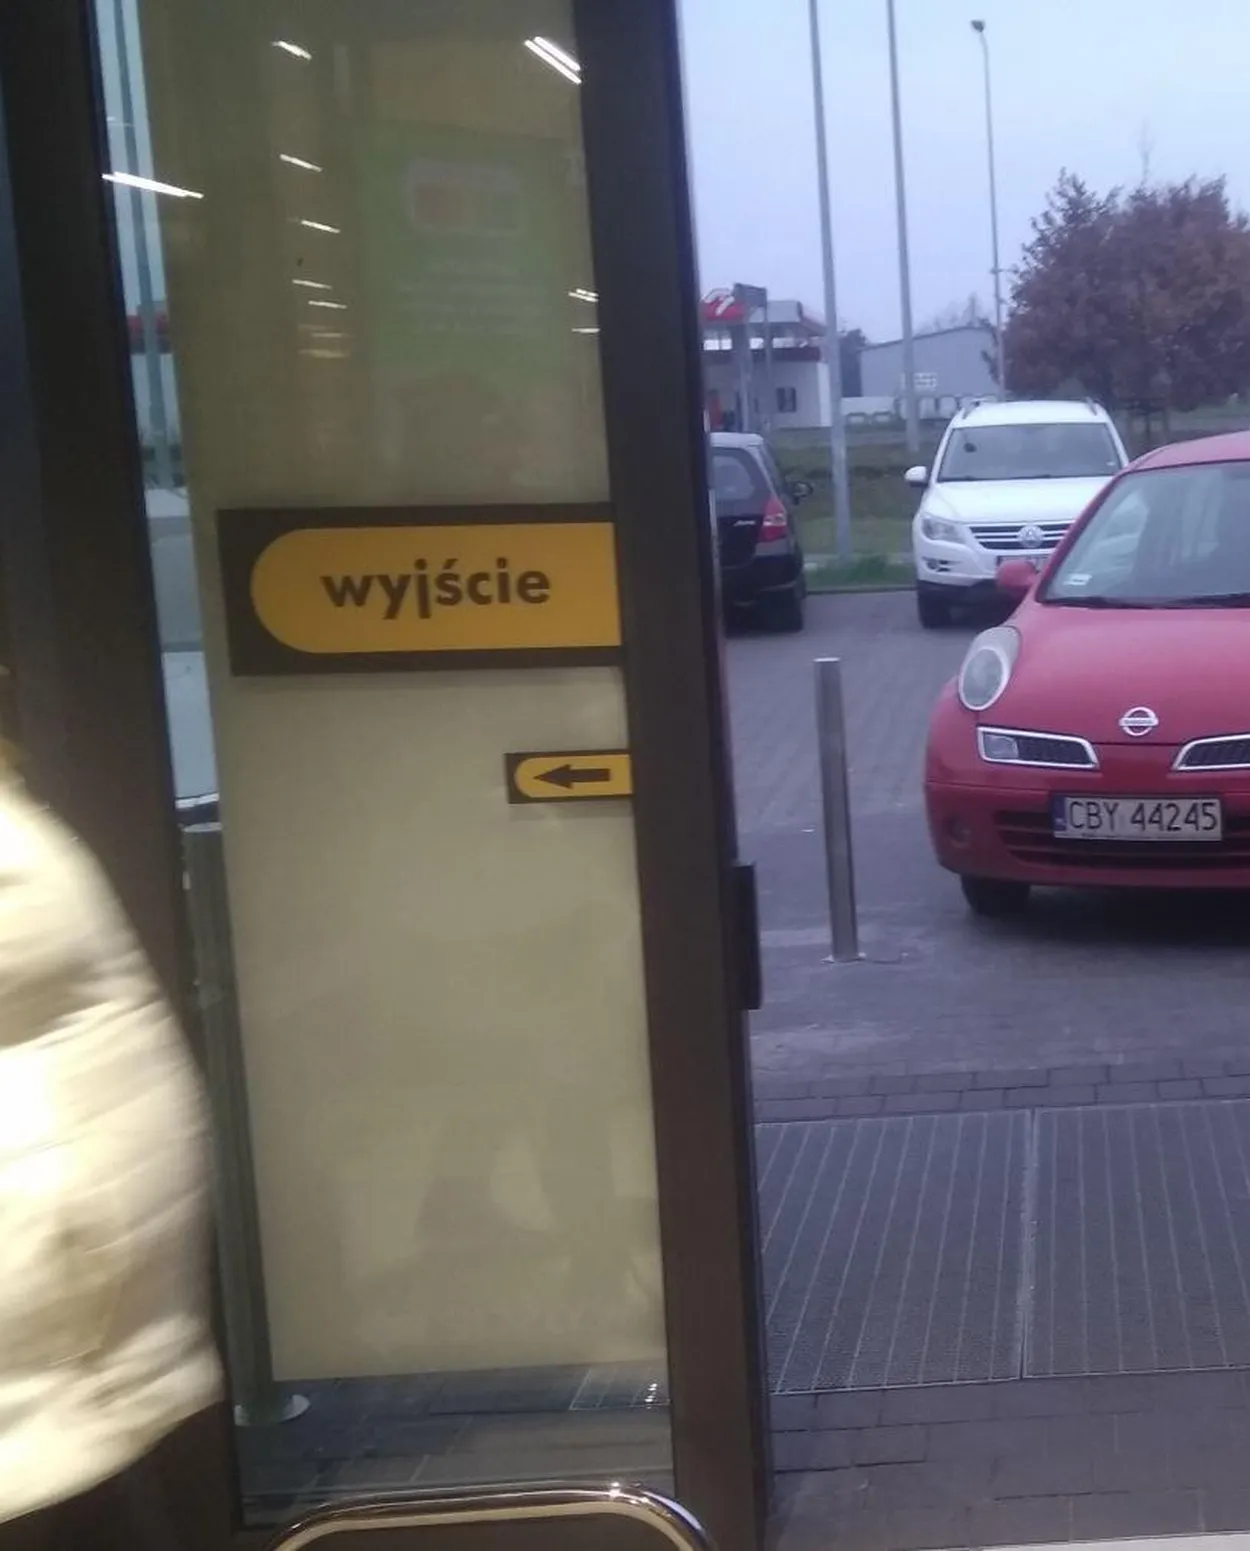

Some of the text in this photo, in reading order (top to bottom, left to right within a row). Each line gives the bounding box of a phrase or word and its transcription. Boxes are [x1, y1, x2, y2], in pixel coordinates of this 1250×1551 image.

[320, 557, 551, 620] wyjście
[1069, 801, 1118, 830] CBY
[1131, 802, 1217, 832] 44245
